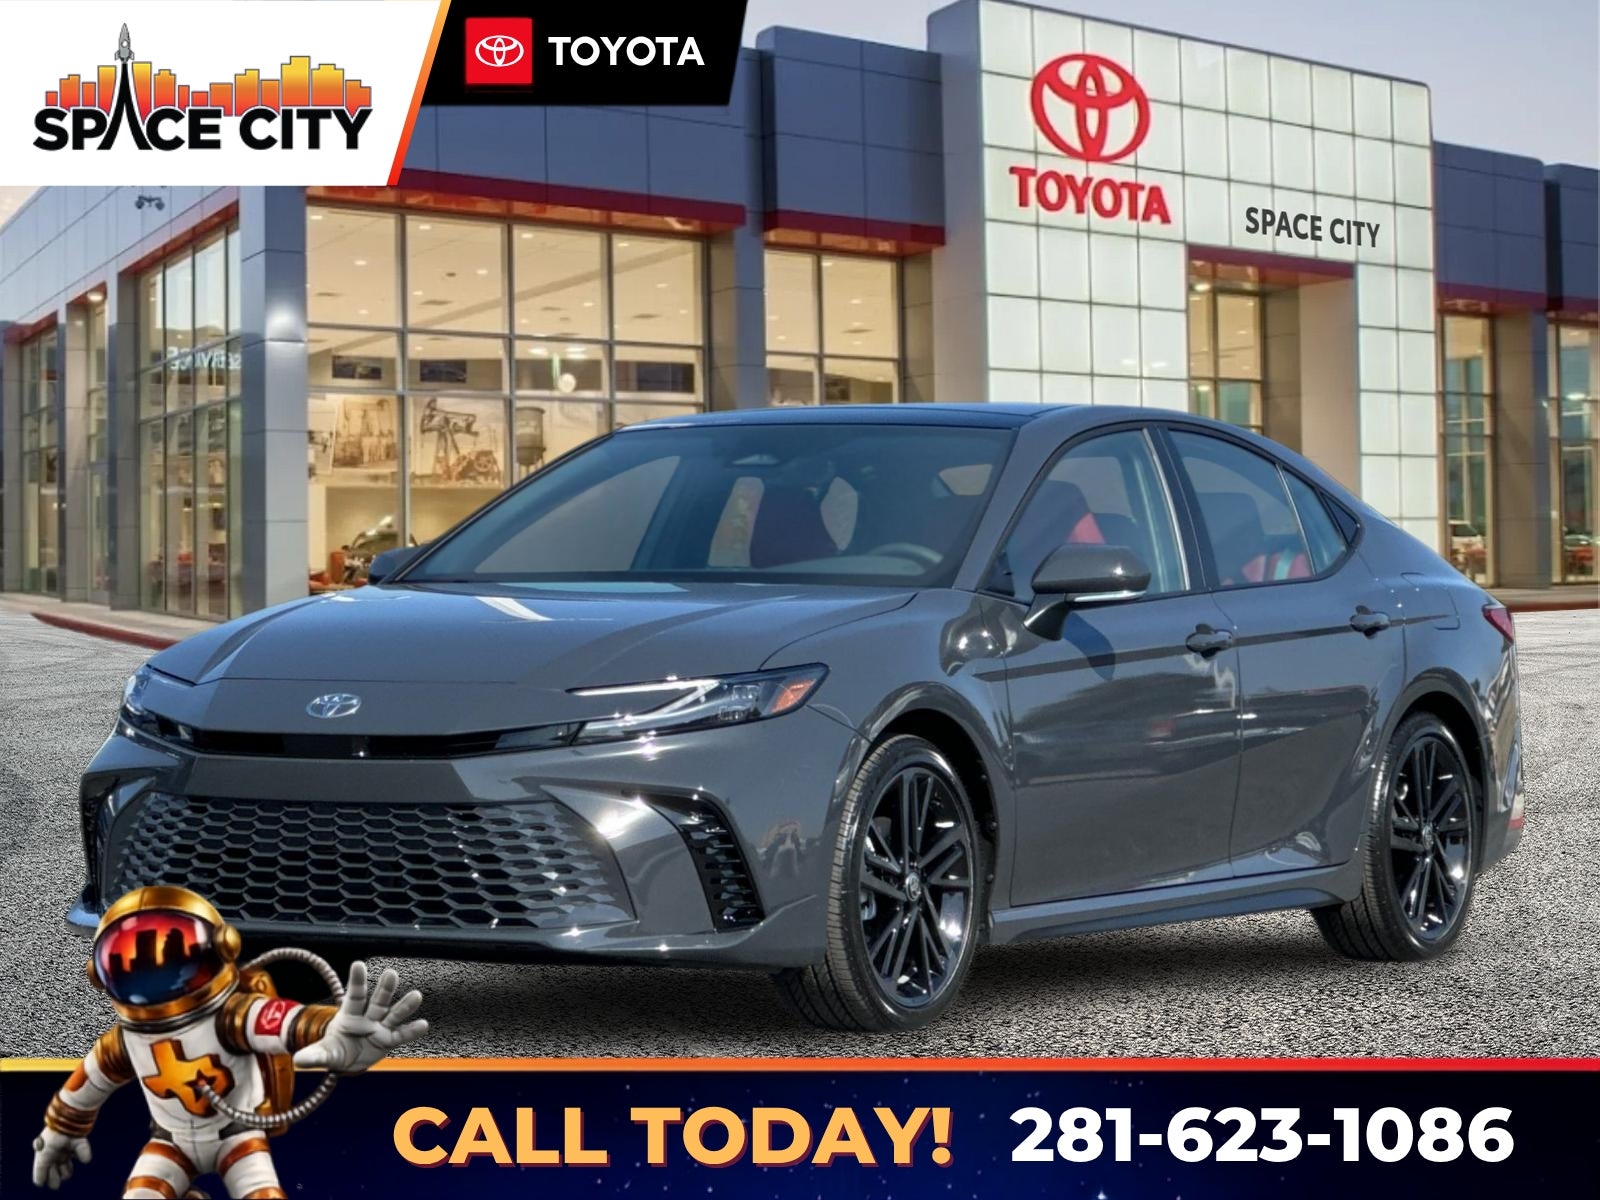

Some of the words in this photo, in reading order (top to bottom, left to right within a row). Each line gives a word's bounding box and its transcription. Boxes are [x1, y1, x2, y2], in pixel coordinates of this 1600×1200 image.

[1009, 166, 1171, 225] TOYOTA
[1245, 206, 1323, 242] SPACE
[1329, 217, 1381, 248] CITY
